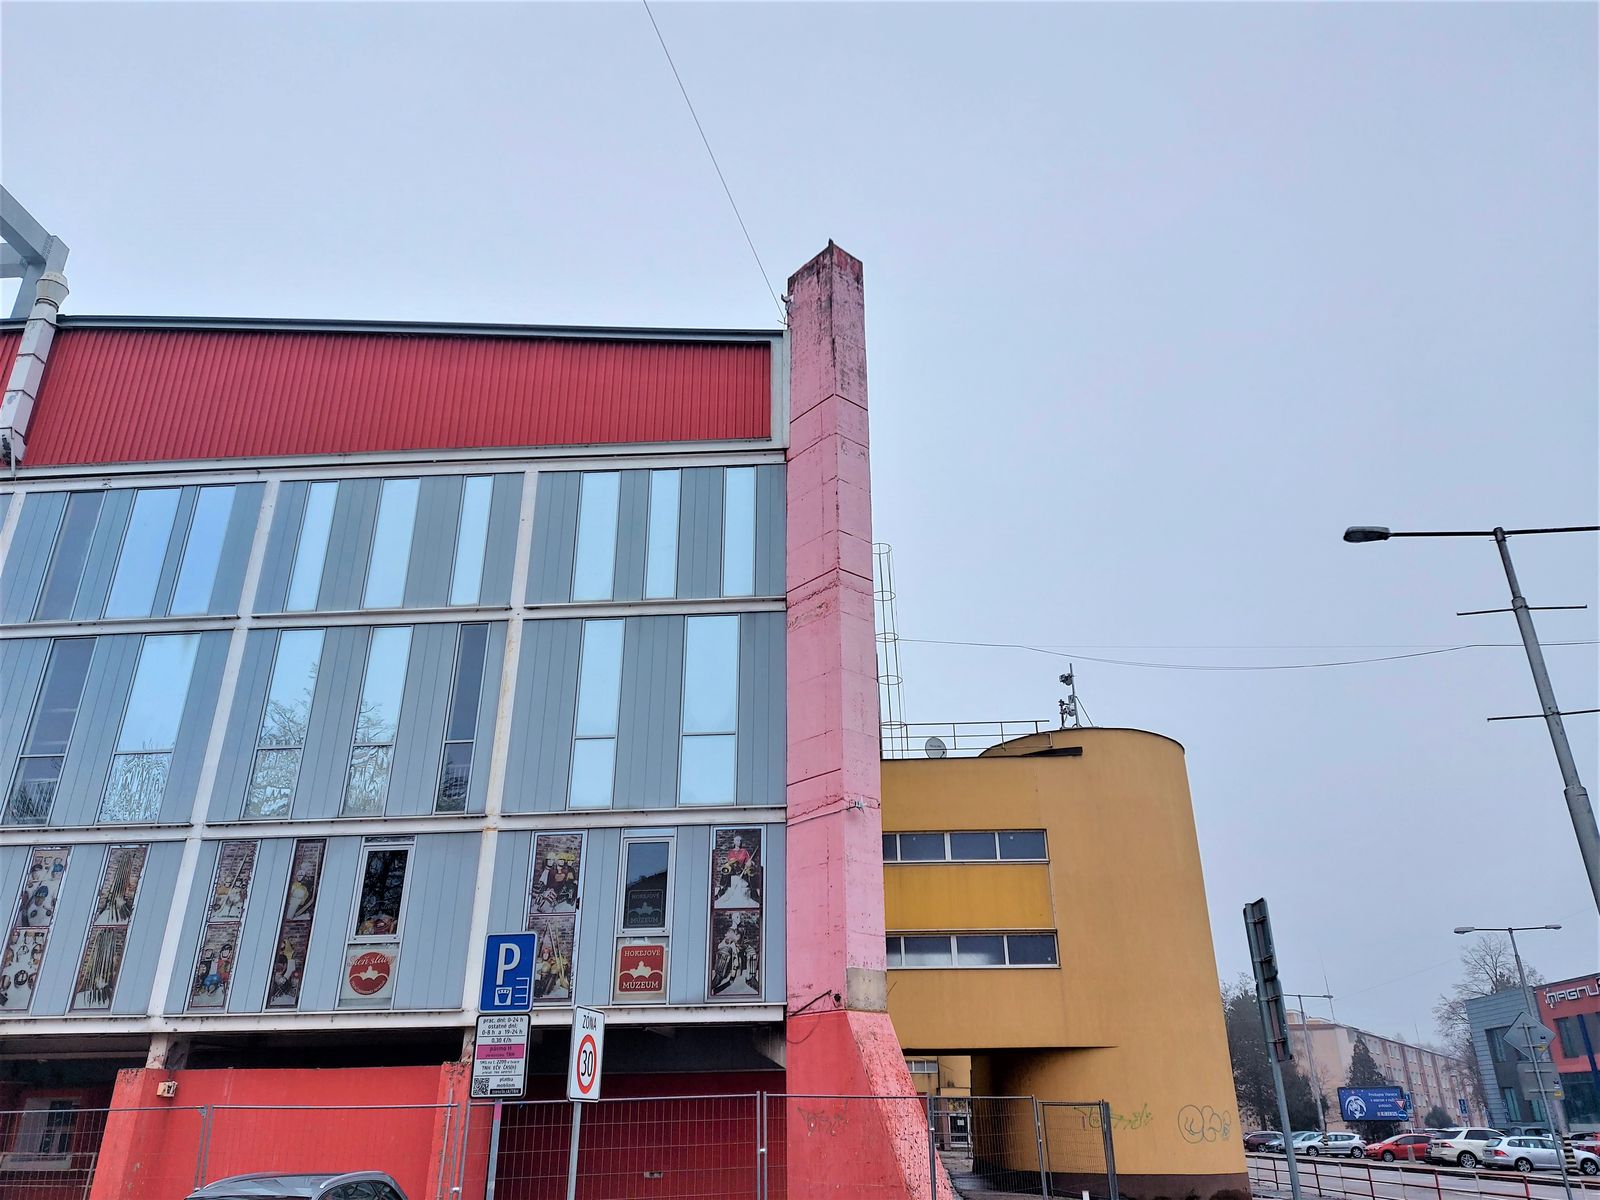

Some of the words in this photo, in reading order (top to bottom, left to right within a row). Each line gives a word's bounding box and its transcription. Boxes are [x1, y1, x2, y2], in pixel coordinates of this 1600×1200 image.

[624, 949, 661, 957] HOKEJOVÉ
[496, 943, 521, 986] P
[622, 979, 659, 989] MÚZEUM
[1546, 983, 1600, 1004] MAGNU
[582, 1012, 597, 1031] ZÓNA
[580, 1049, 594, 1077] 30
